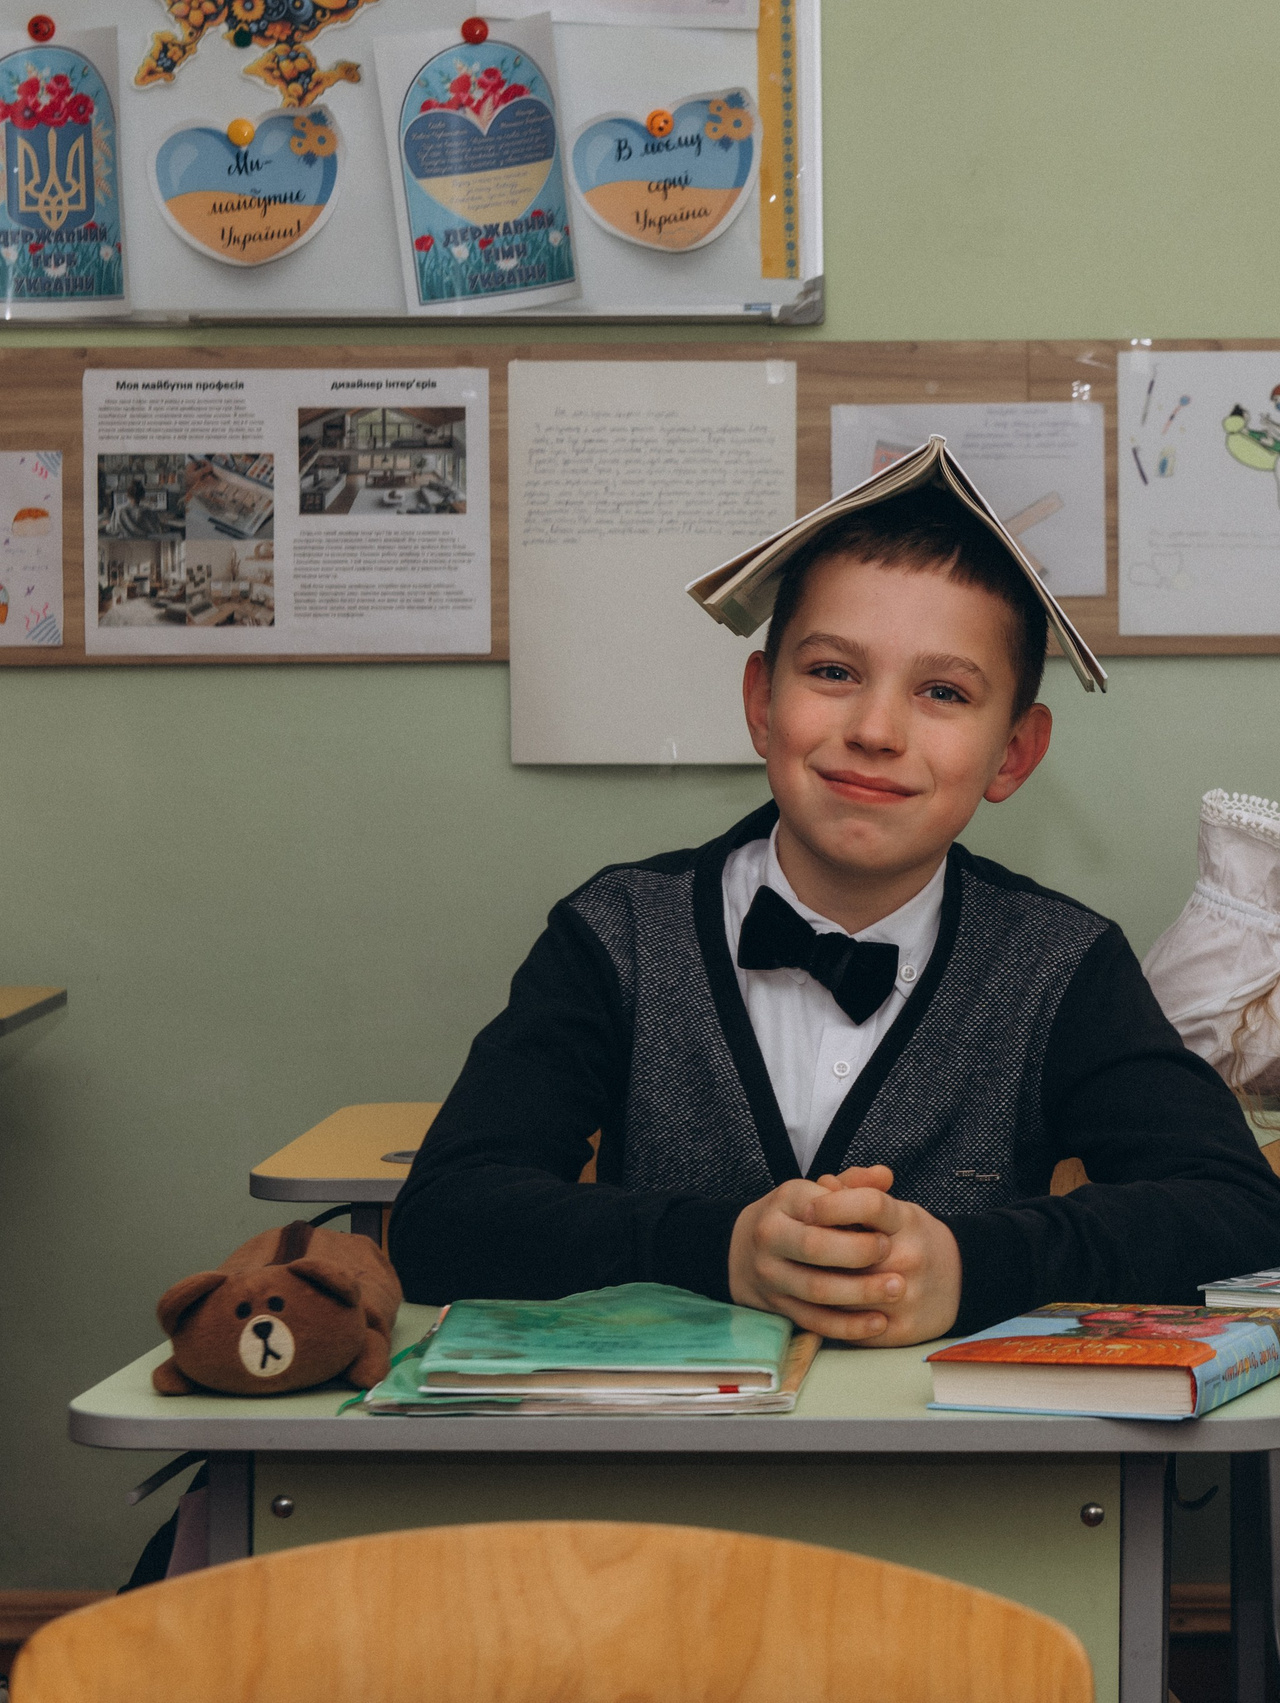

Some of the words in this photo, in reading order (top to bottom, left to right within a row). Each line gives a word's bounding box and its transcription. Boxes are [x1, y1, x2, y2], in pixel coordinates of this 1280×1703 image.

[615, 138, 632, 162] В
[640, 133, 702, 157] моєму
[647, 170, 693, 201] серці
[443, 209, 555, 248] ДЕРЖАВНИЙ
[634, 207, 711, 234] Україна
[221, 219, 301, 251] України!
[468, 263, 547, 290] УКРАЇНИ
[115, 380, 139, 391] Моя
[141, 379, 193, 392] майбутня
[195, 379, 245, 392] професія
[330, 378, 383, 391] дизайнер
